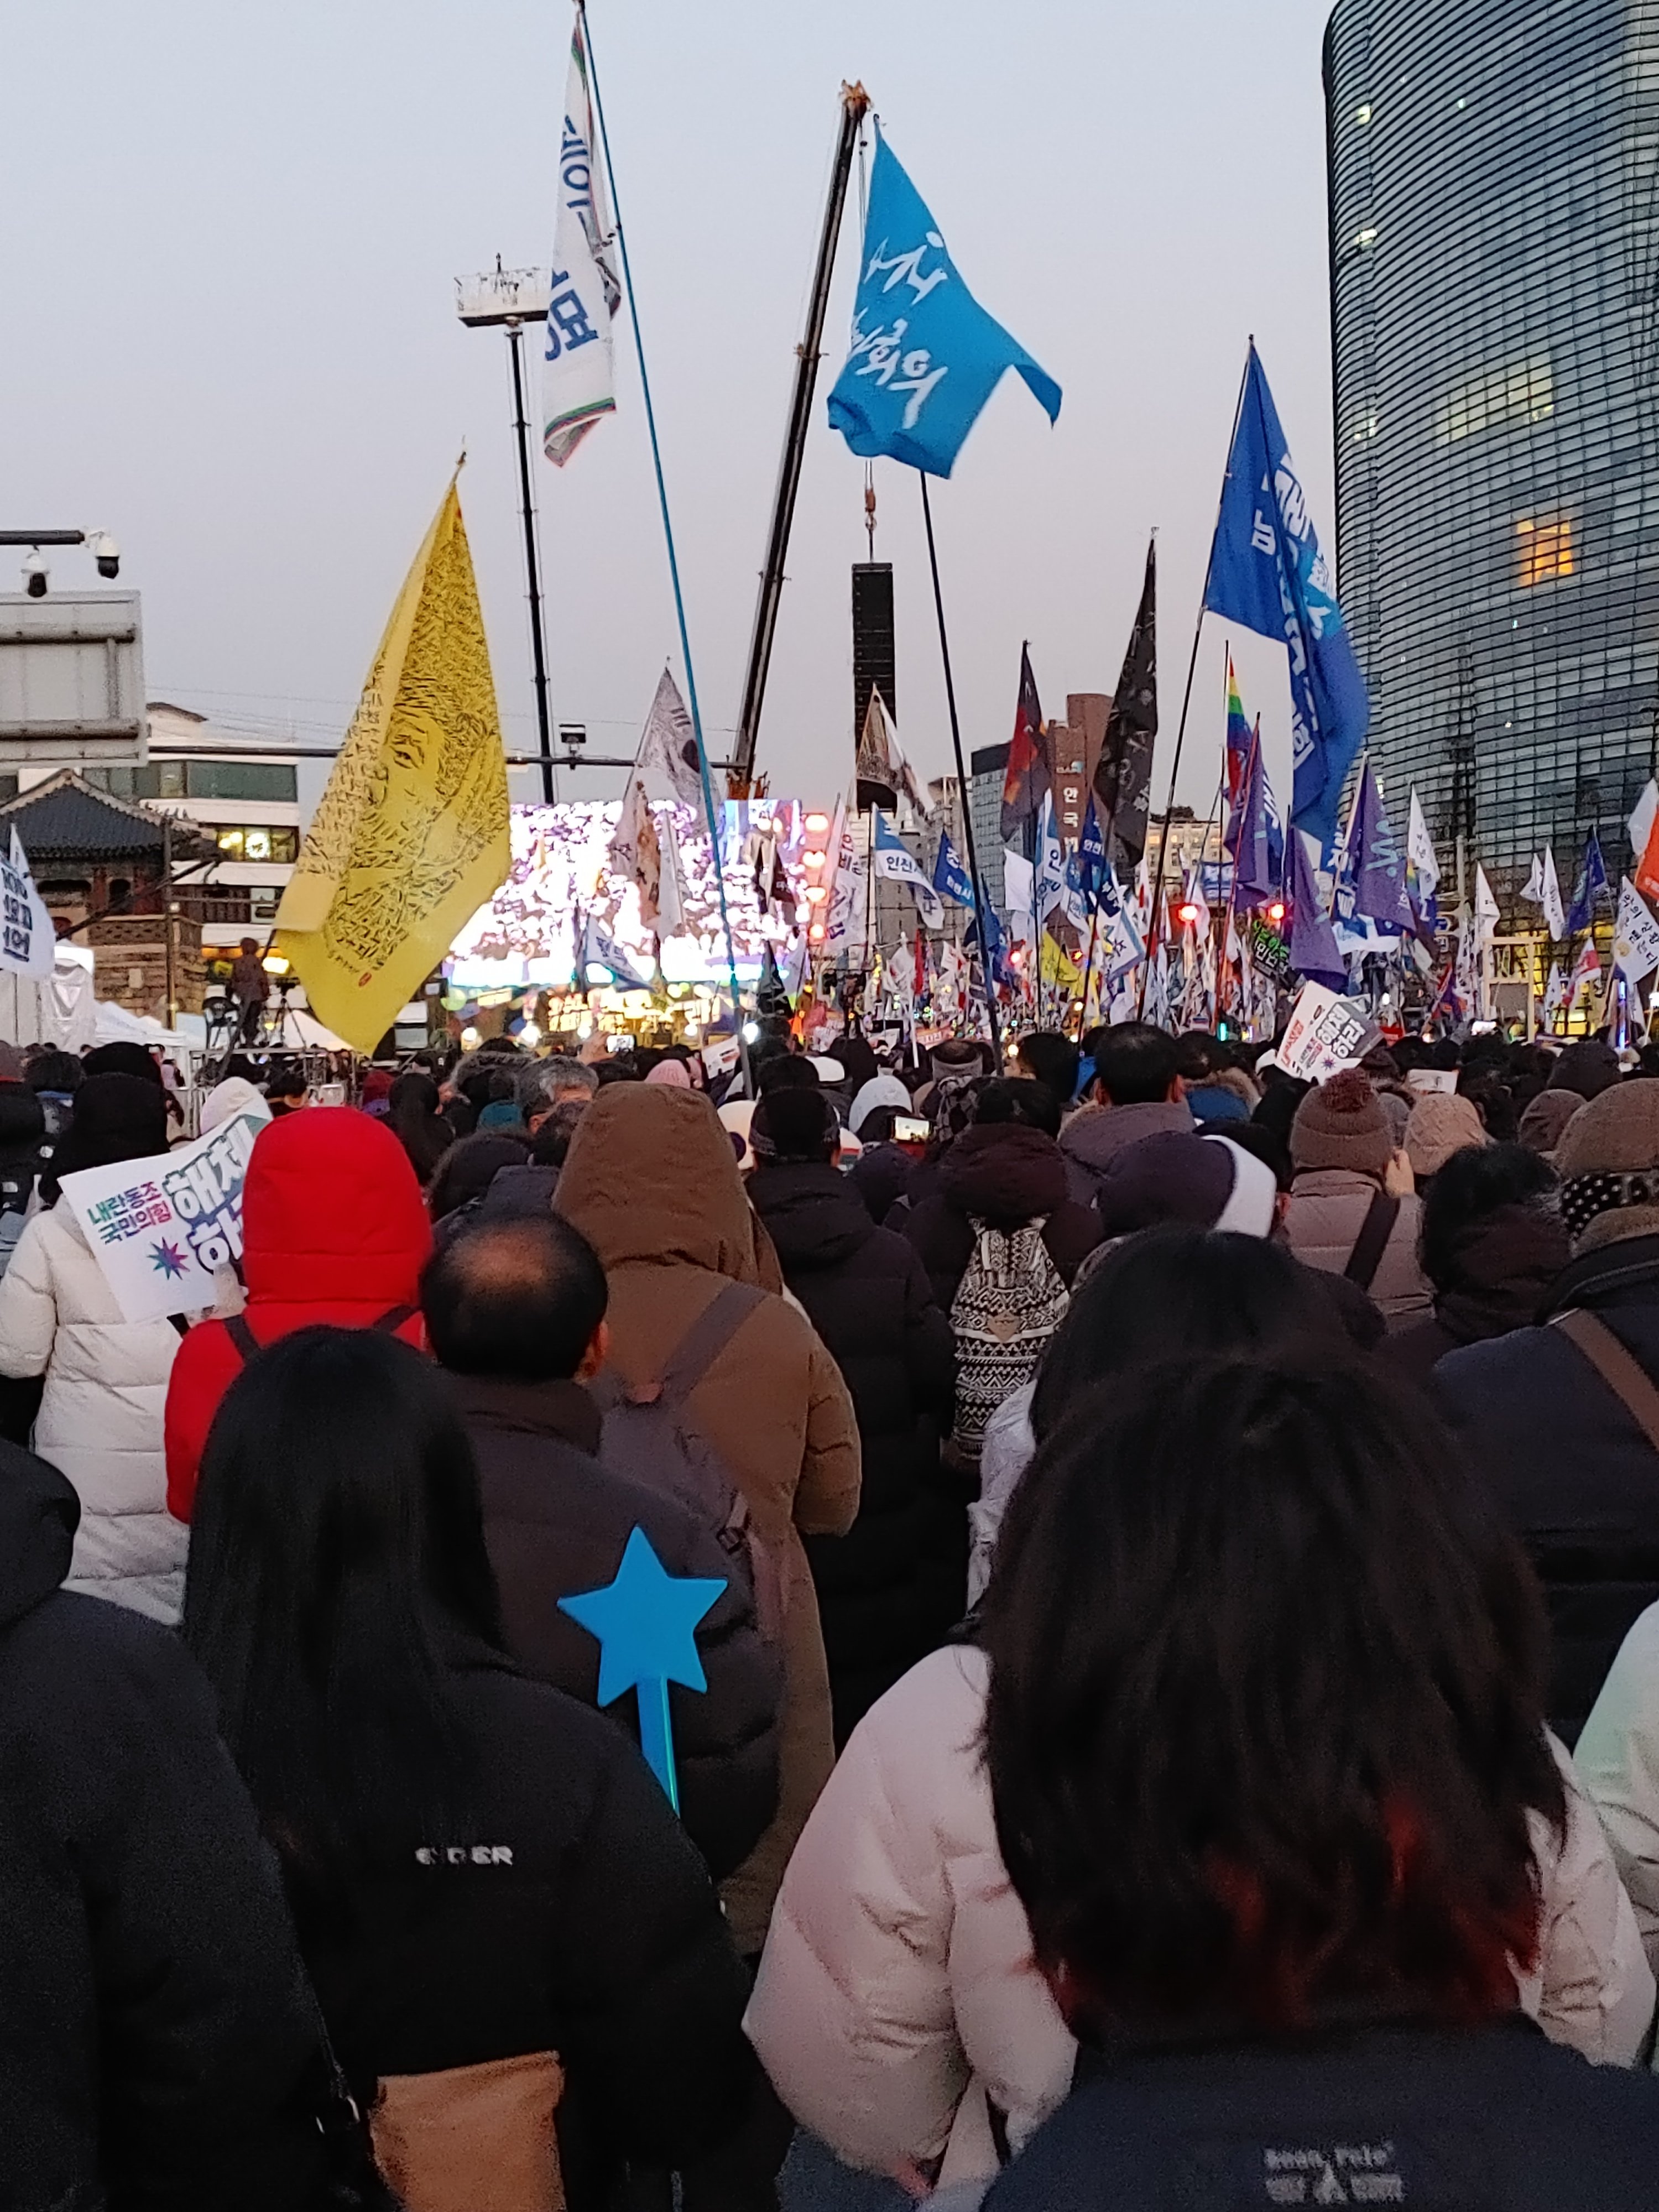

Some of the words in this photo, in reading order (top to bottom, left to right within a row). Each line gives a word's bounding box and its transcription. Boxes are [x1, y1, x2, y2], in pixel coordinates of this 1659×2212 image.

[1331, 1018, 1366, 1059] 하라
[87, 1181, 162, 1225] 내란동조
[98, 1201, 172, 1245] 국민의힘
